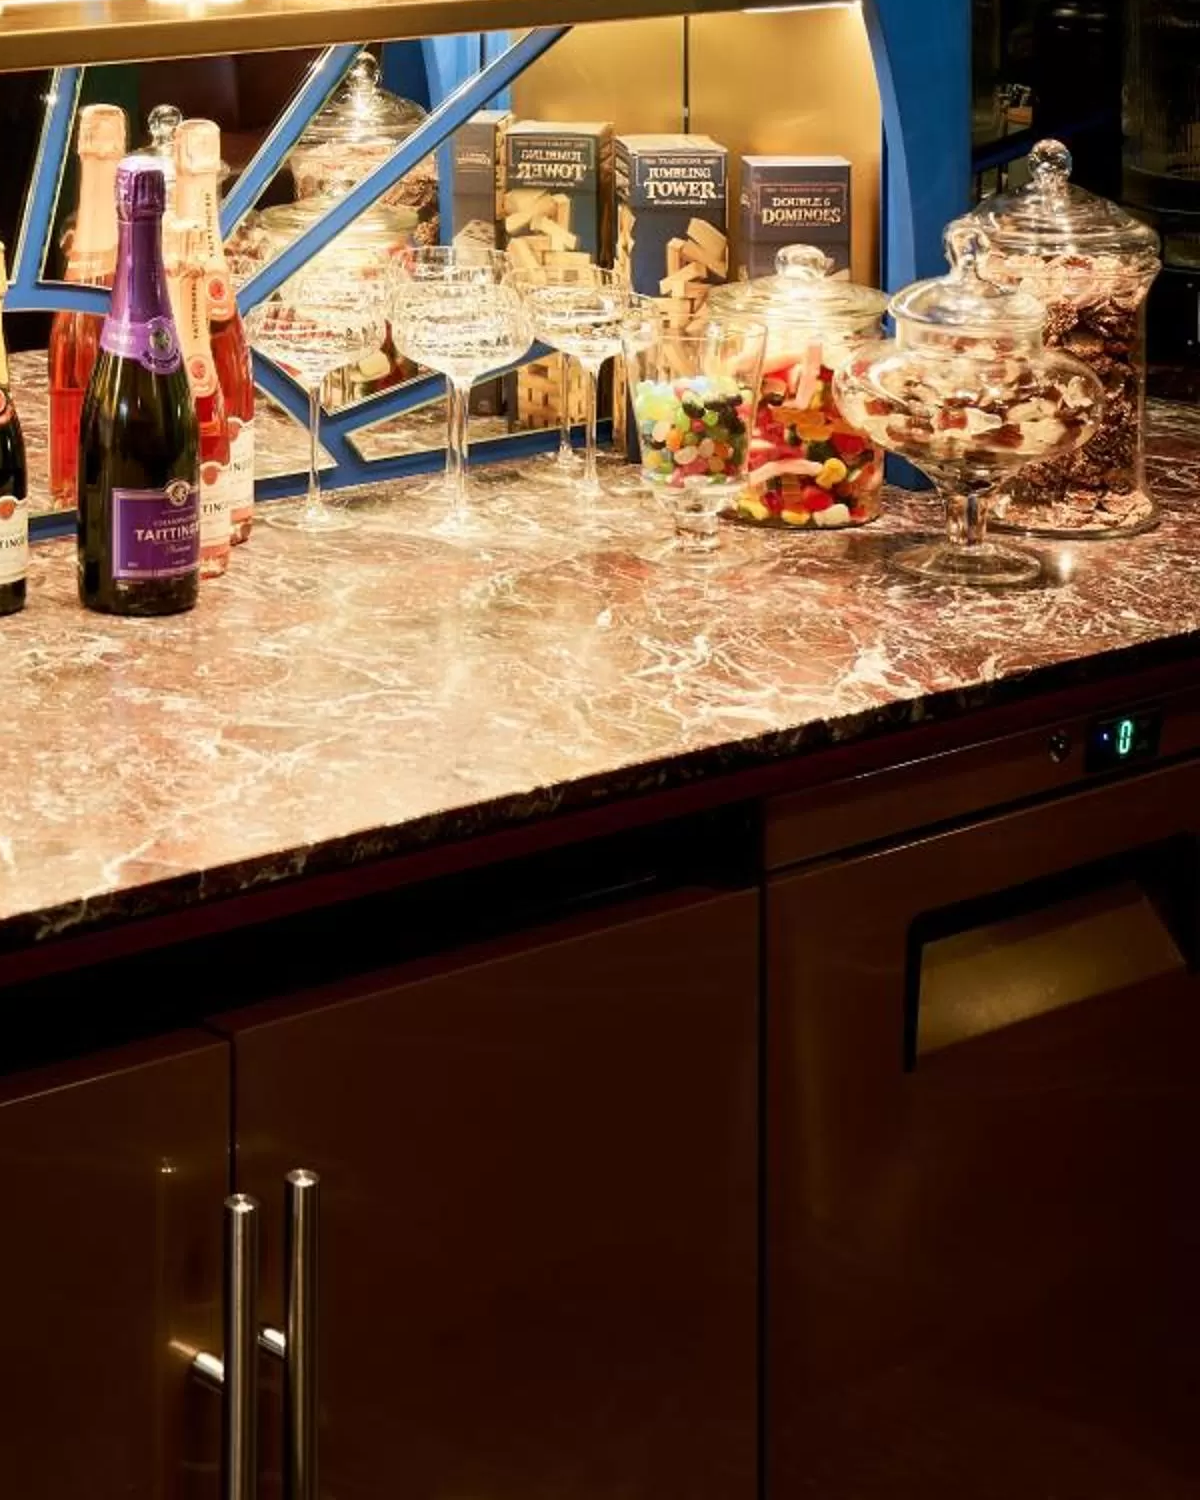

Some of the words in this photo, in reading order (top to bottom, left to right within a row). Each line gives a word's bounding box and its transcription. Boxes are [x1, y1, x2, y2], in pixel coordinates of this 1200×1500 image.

[643, 180, 717, 199] TOWER
[771, 196, 822, 208] DOUBLE
[761, 206, 841, 225] DOMINOES
